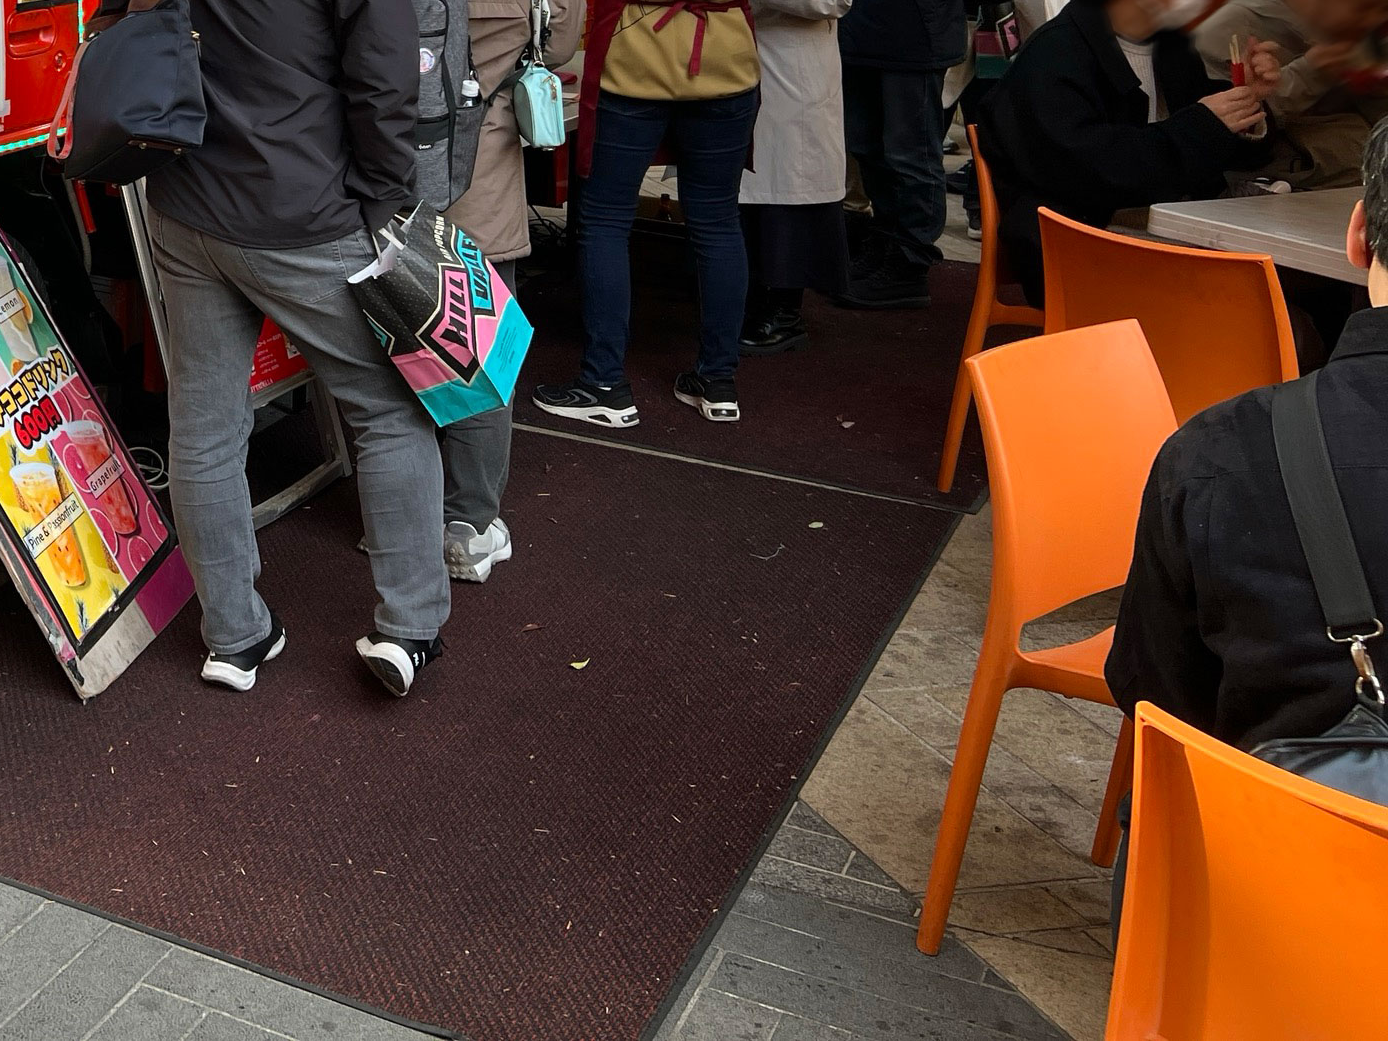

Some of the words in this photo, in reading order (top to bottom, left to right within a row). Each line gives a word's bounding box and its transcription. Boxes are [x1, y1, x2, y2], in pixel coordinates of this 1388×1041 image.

[439, 276, 469, 350] HILL
[14, 394, 63, 450] 600円
[90, 458, 121, 492] Grapefruit
[27, 533, 44, 551] Pine
[46, 499, 80, 531] Passionfruit
